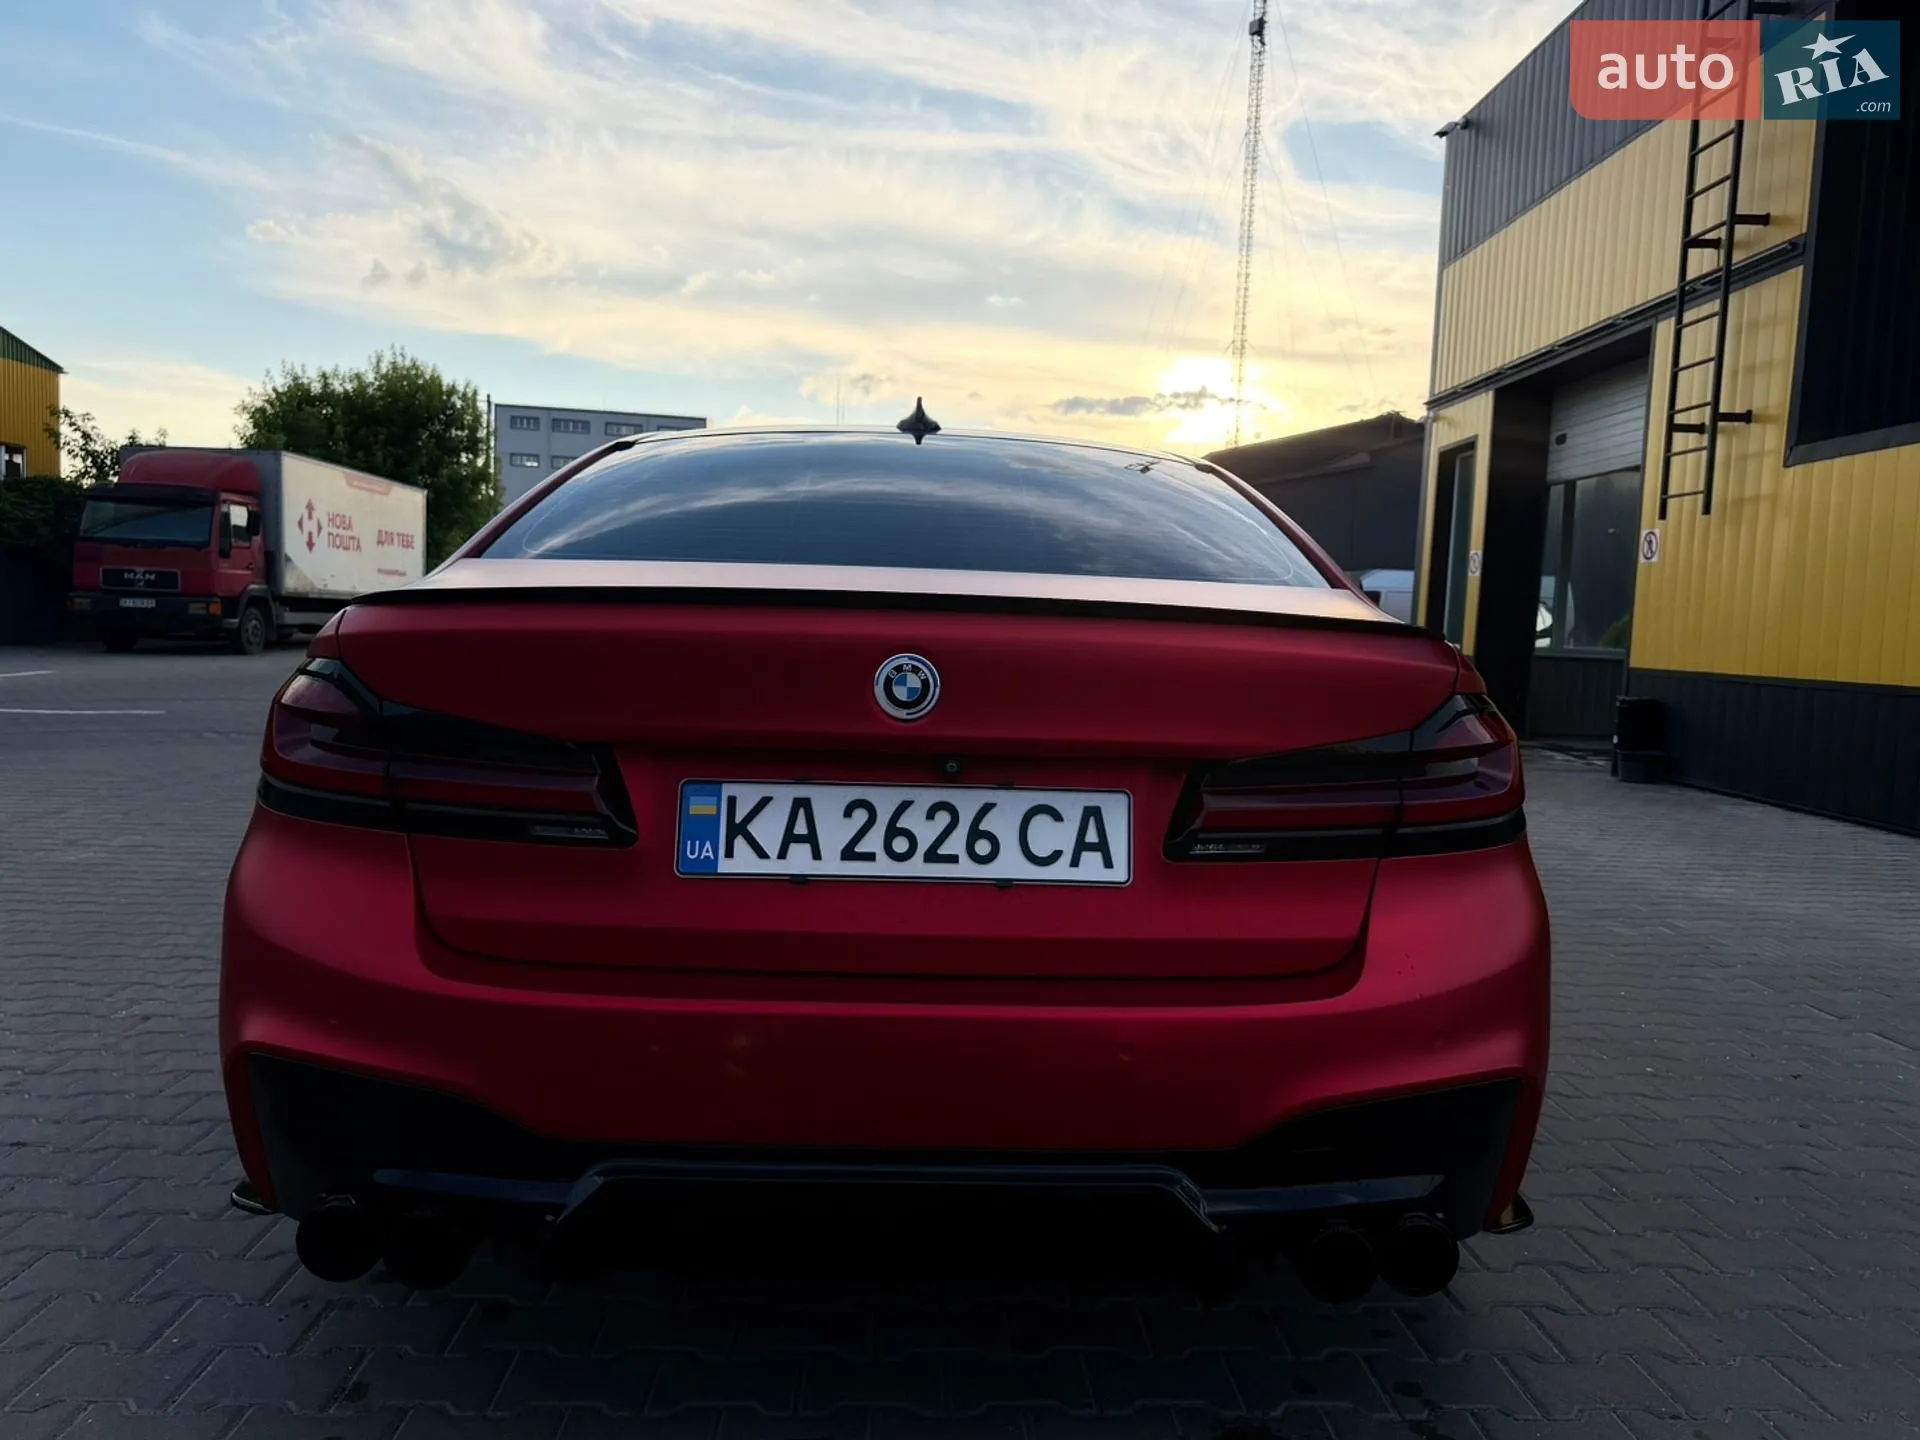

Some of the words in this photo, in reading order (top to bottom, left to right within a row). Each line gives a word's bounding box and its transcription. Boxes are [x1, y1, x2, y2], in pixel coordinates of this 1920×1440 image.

[327, 511, 353, 531] НОВА
[327, 532, 362, 552] ПОШТА
[376, 529, 394, 548] ДЛЯ
[397, 532, 415, 550] ТЕБЕ
[123, 572, 156, 580] MAN
[888, 664, 927, 680] BMW
[724, 796, 822, 861] KA
[840, 799, 1000, 865] 2626
[1019, 804, 1114, 869] CA
[686, 840, 714, 860] UA
